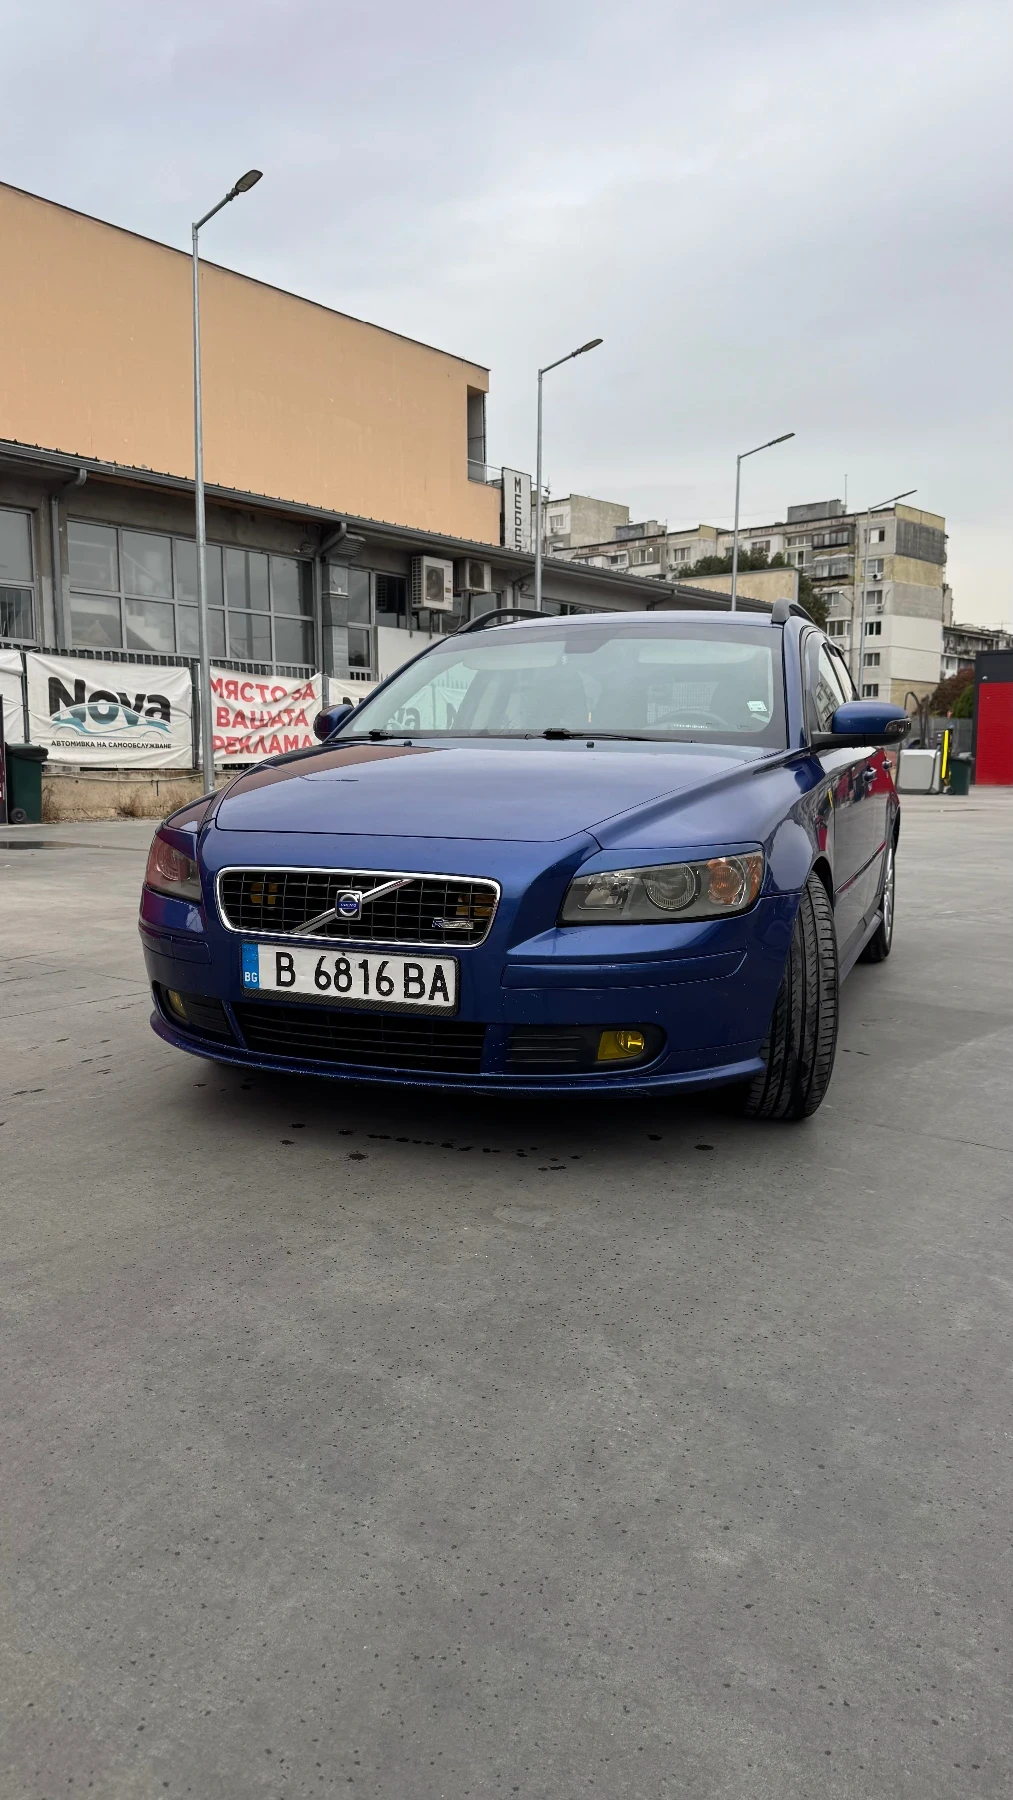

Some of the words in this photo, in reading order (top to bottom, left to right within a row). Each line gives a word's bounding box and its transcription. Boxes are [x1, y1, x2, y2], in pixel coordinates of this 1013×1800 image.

[48, 676, 171, 726] Nova
[210, 677, 288, 703] МЯСТО
[291, 681, 317, 701] ЗА
[216, 706, 310, 730] ВАШАТА
[51, 740, 96, 748] АВТОМИВКА
[212, 734, 313, 755] РЕКЛАМА
[244, 971, 258, 982] BG
[275, 951, 296, 987] B
[314, 955, 395, 997] 6816
[403, 962, 450, 1002] BA
